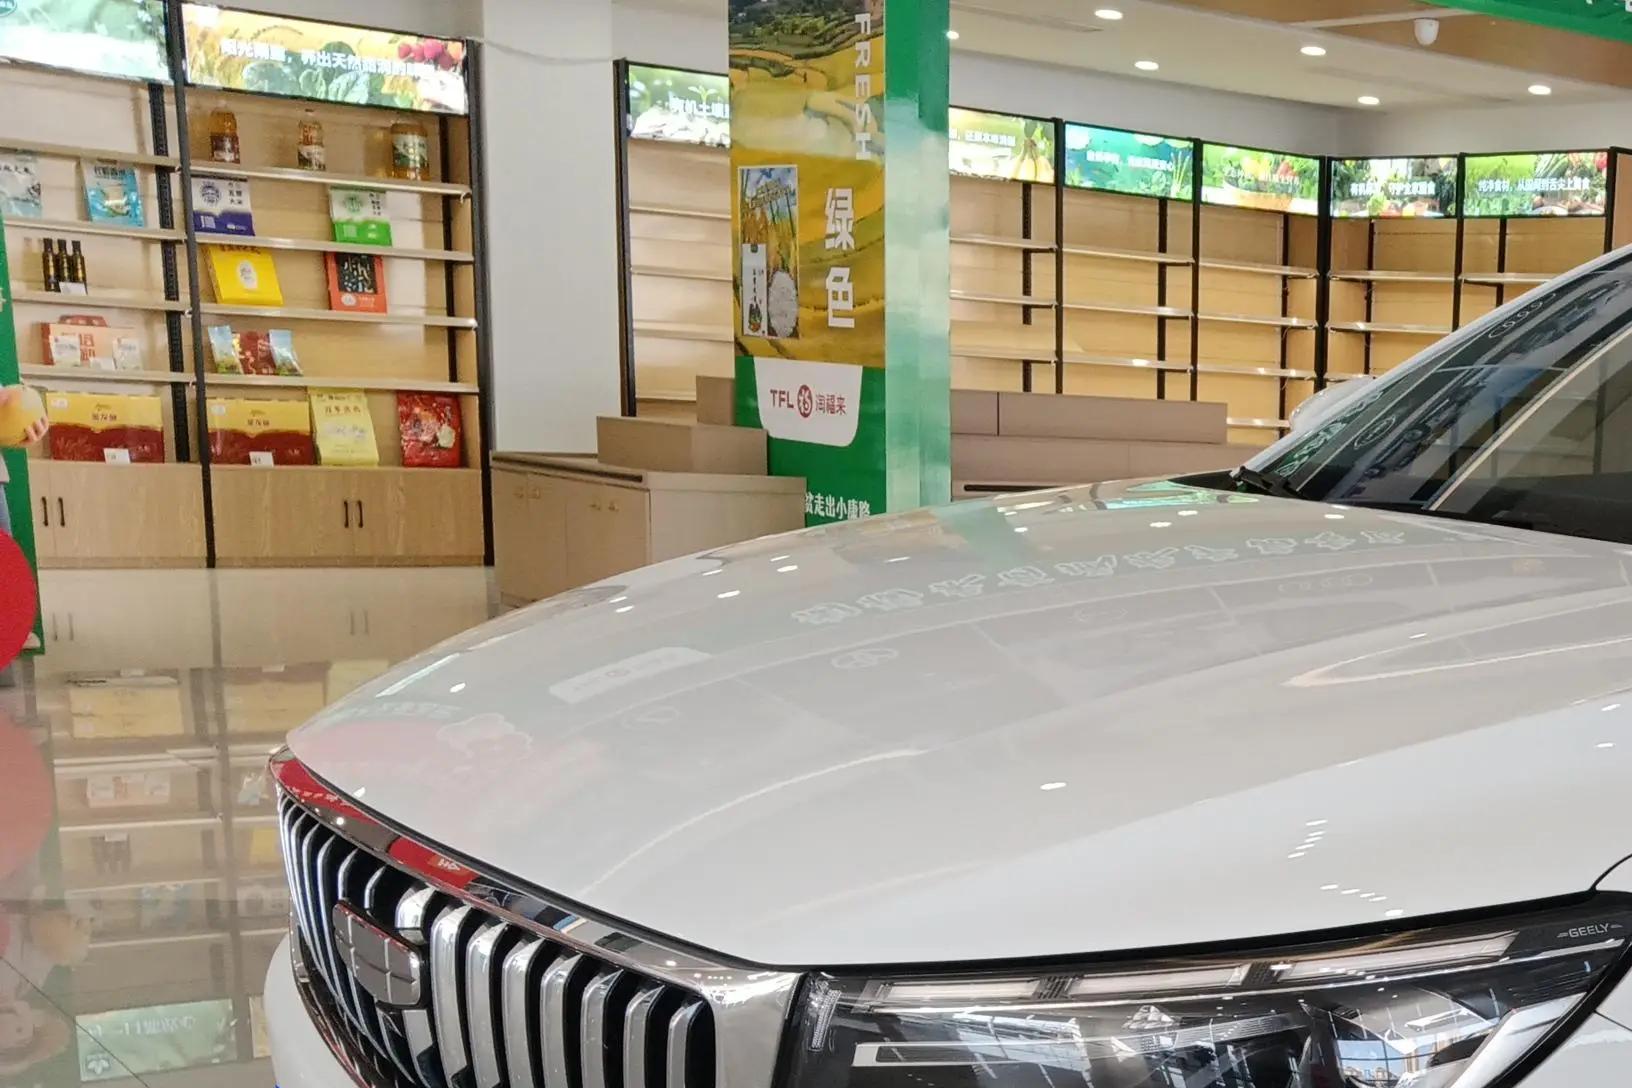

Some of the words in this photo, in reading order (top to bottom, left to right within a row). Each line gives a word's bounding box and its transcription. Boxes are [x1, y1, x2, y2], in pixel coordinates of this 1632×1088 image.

[855, 13, 872, 161] FRESH
[824, 187, 855, 328] 绿色
[770, 389, 795, 409] TFL
[815, 392, 847, 416] 淘福来
[1568, 922, 1610, 938] GEELY
